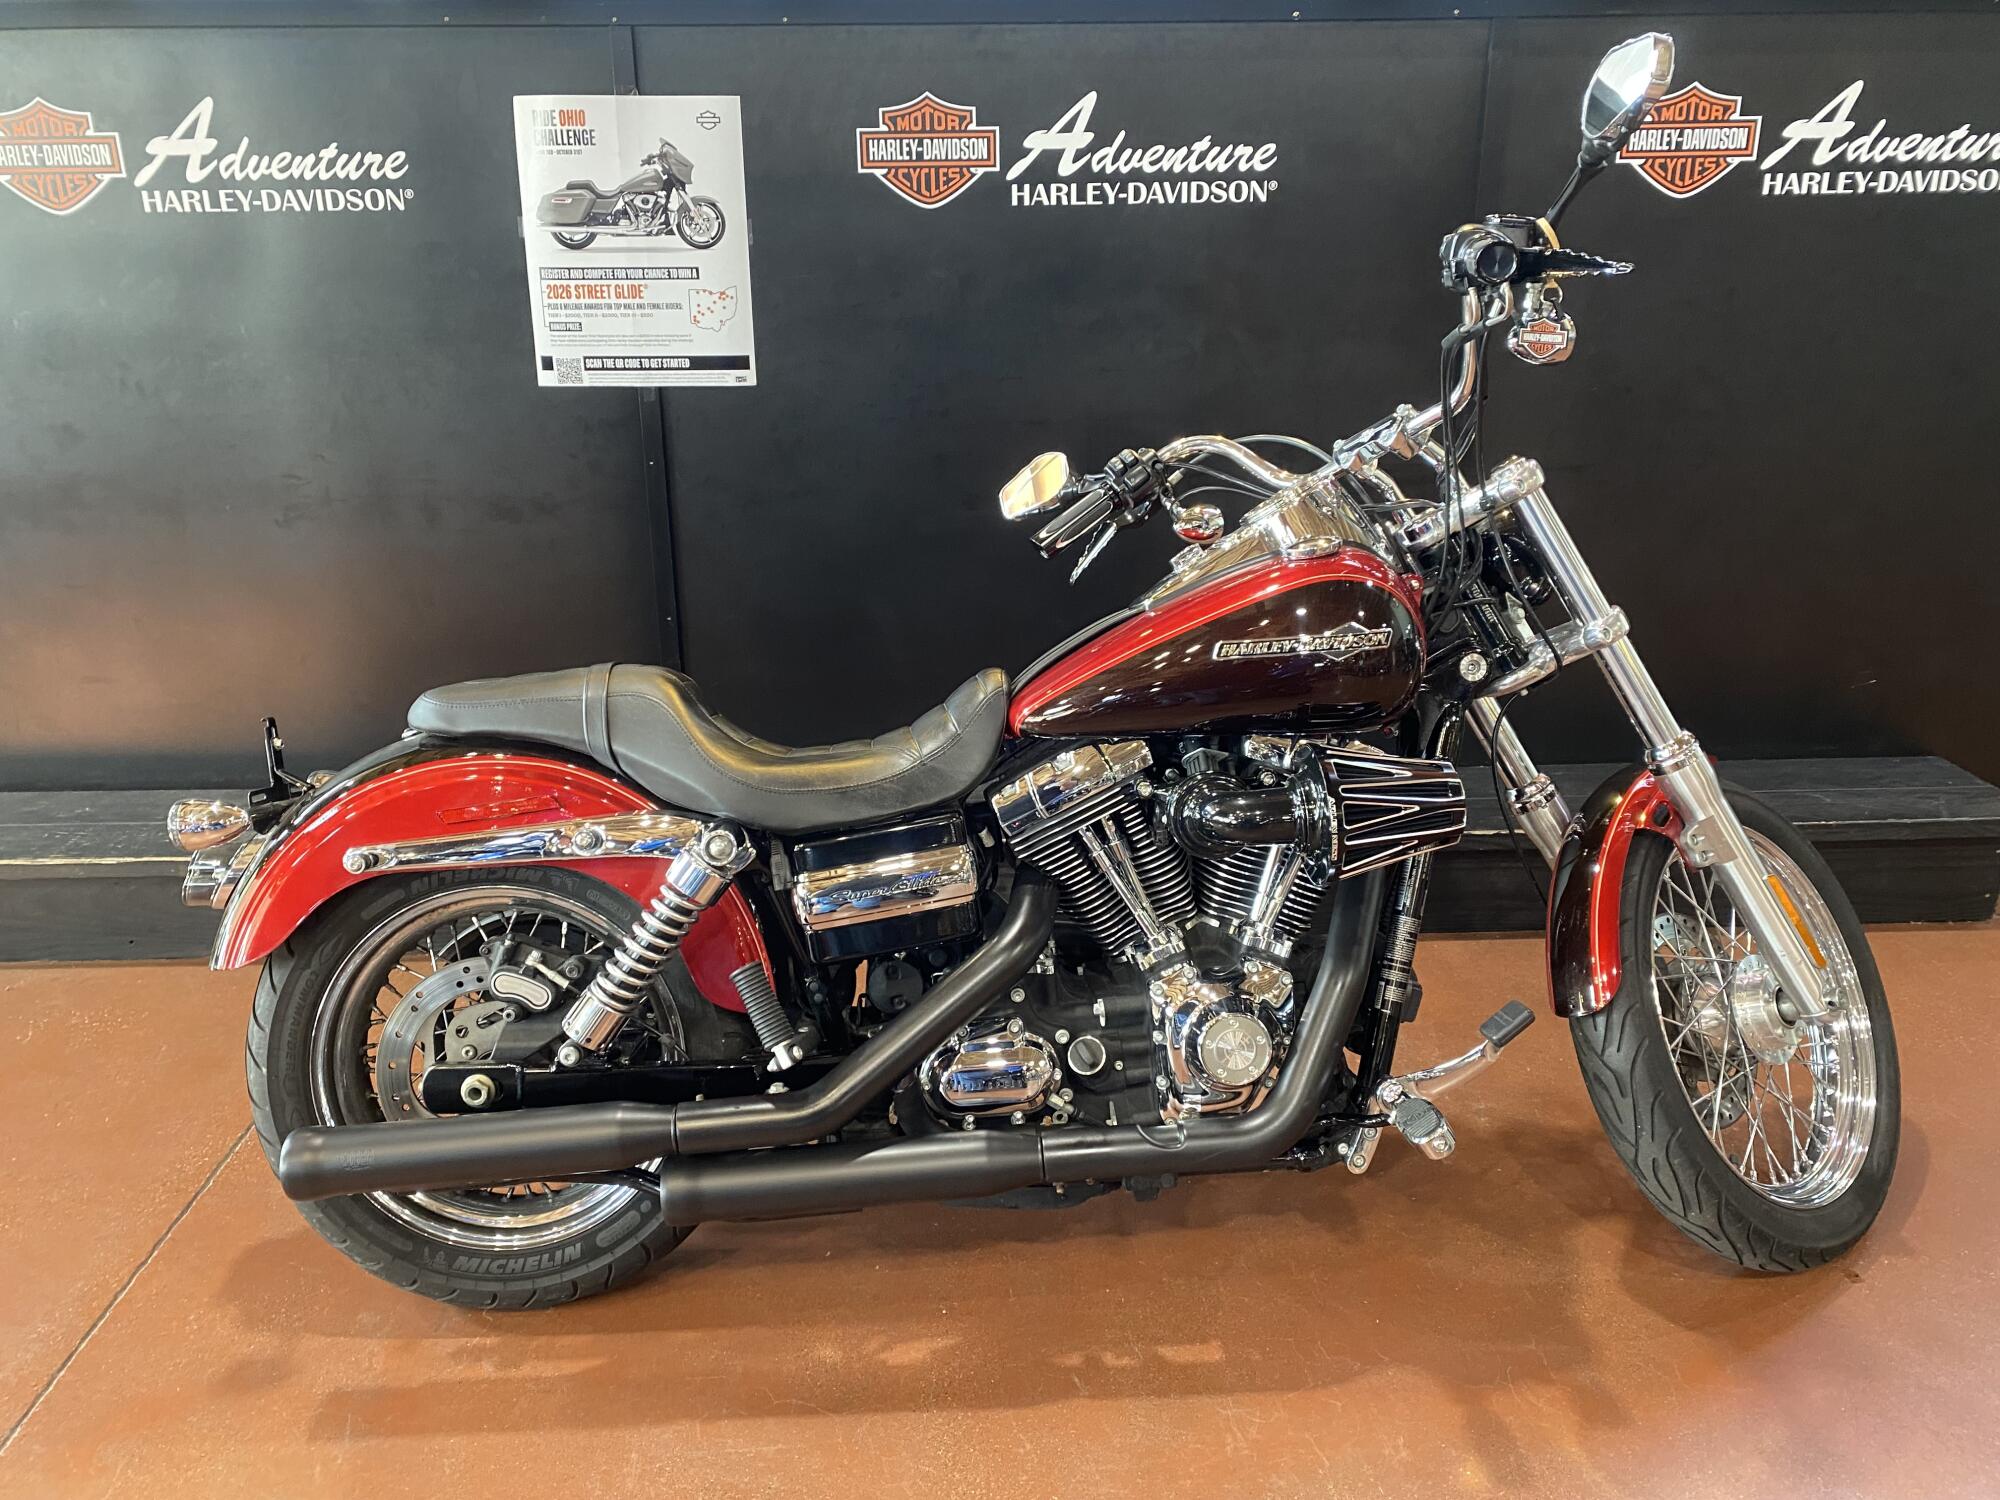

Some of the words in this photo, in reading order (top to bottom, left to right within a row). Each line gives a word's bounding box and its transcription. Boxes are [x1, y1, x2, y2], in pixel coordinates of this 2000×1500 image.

[532, 109, 557, 127] RIDE
[559, 109, 586, 127] OHIO
[896, 106, 960, 131] MOTOR
[1661, 96, 1724, 121] MOTOR
[11, 112, 77, 136] MOTOR
[1006, 90, 1278, 181] Adventure
[134, 96, 410, 187] Adventure
[534, 129, 597, 146] CHALLENGE
[869, 138, 988, 160] HARLEY-DAVIDSON
[1629, 128, 1749, 151] HARLEY-DAVIDSON
[0, 144, 112, 166] ARLEY-DAVIDSON
[898, 167, 961, 197] CYCLES
[1654, 157, 1717, 186] CYCLES
[1762, 168, 2000, 195] HARLEY-DAVIDSO
[22, 174, 88, 203] CYCLES
[542, 268, 570, 279] REGISTER
[570, 268, 583, 279] AND
[583, 268, 614, 279] COMPETE
[614, 268, 627, 279] FOR
[627, 268, 643, 279] YOUR
[644, 268, 669, 279] CHANCE
[669, 268, 677, 279] TO
[678, 268, 691, 279] WIN
[692, 268, 697, 279] A
[546, 284, 572, 299] 2026
[574, 284, 612, 299] STREET
[585, 358, 602, 368] SCAN
[603, 358, 615, 368] THE
[615, 358, 624, 368] QR
[624, 358, 640, 368] CODE
[641, 358, 650, 368] TO
[650, 358, 662, 368] GET
[662, 358, 690, 368] STARTED
[1220, 632, 1388, 657] HARLEY-DAVIDSON
[452, 1242, 583, 1274] MICHELIN
